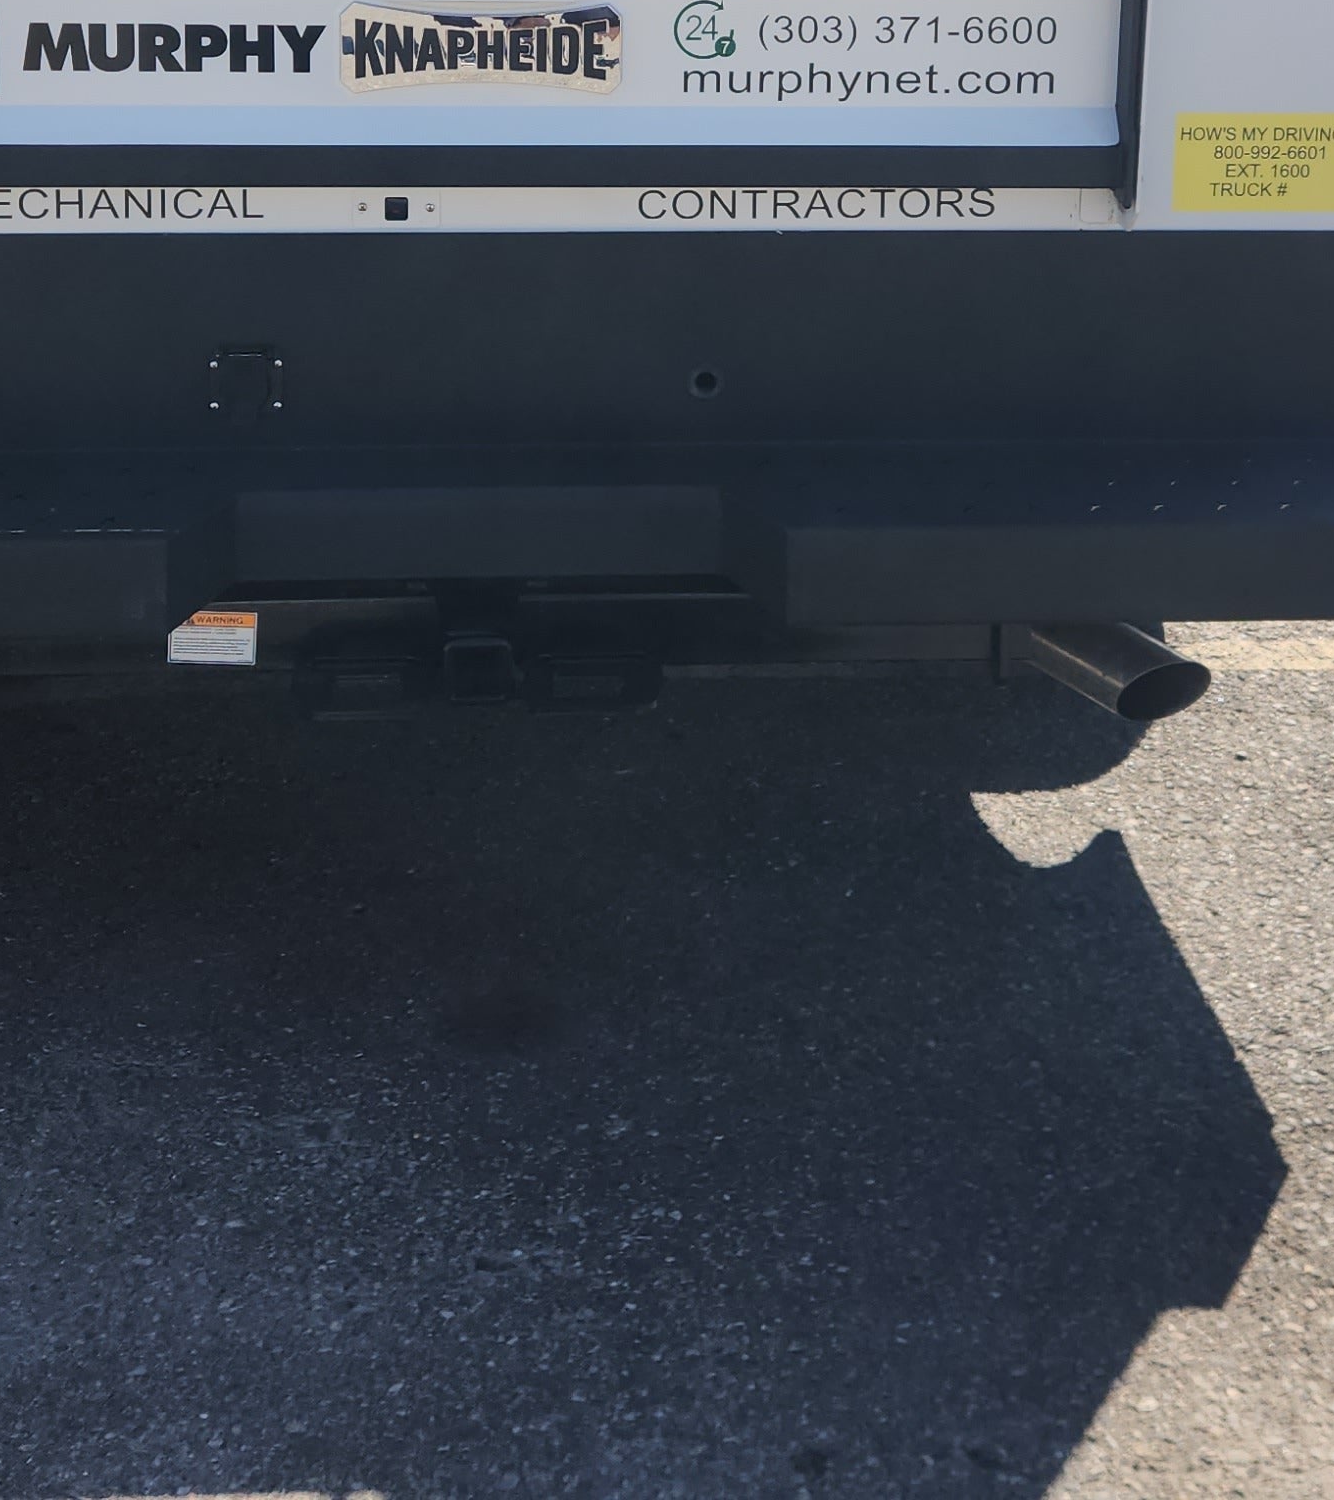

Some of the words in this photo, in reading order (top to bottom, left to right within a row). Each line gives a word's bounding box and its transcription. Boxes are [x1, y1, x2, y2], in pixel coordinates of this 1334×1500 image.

[758, 14, 858, 52] (303)
[874, 15, 1058, 45] 371-6600
[22, 22, 327, 73] MURPHY
[354, 18, 607, 80] KNAPHEIDE
[683, 62, 1056, 102] murphynet.com
[1180, 127, 1237, 141] HOW'S
[1242, 127, 1269, 141] MY
[1213, 145, 1326, 160] 800-992-6601
[1225, 163, 1264, 178] EXT.
[1270, 164, 1310, 178] 1600
[1209, 182, 1273, 197] TRUCK
[1277, 183, 1288, 197] #
[637, 187, 996, 220] CONTRACTORS
[195, 615, 245, 625] WARNING
